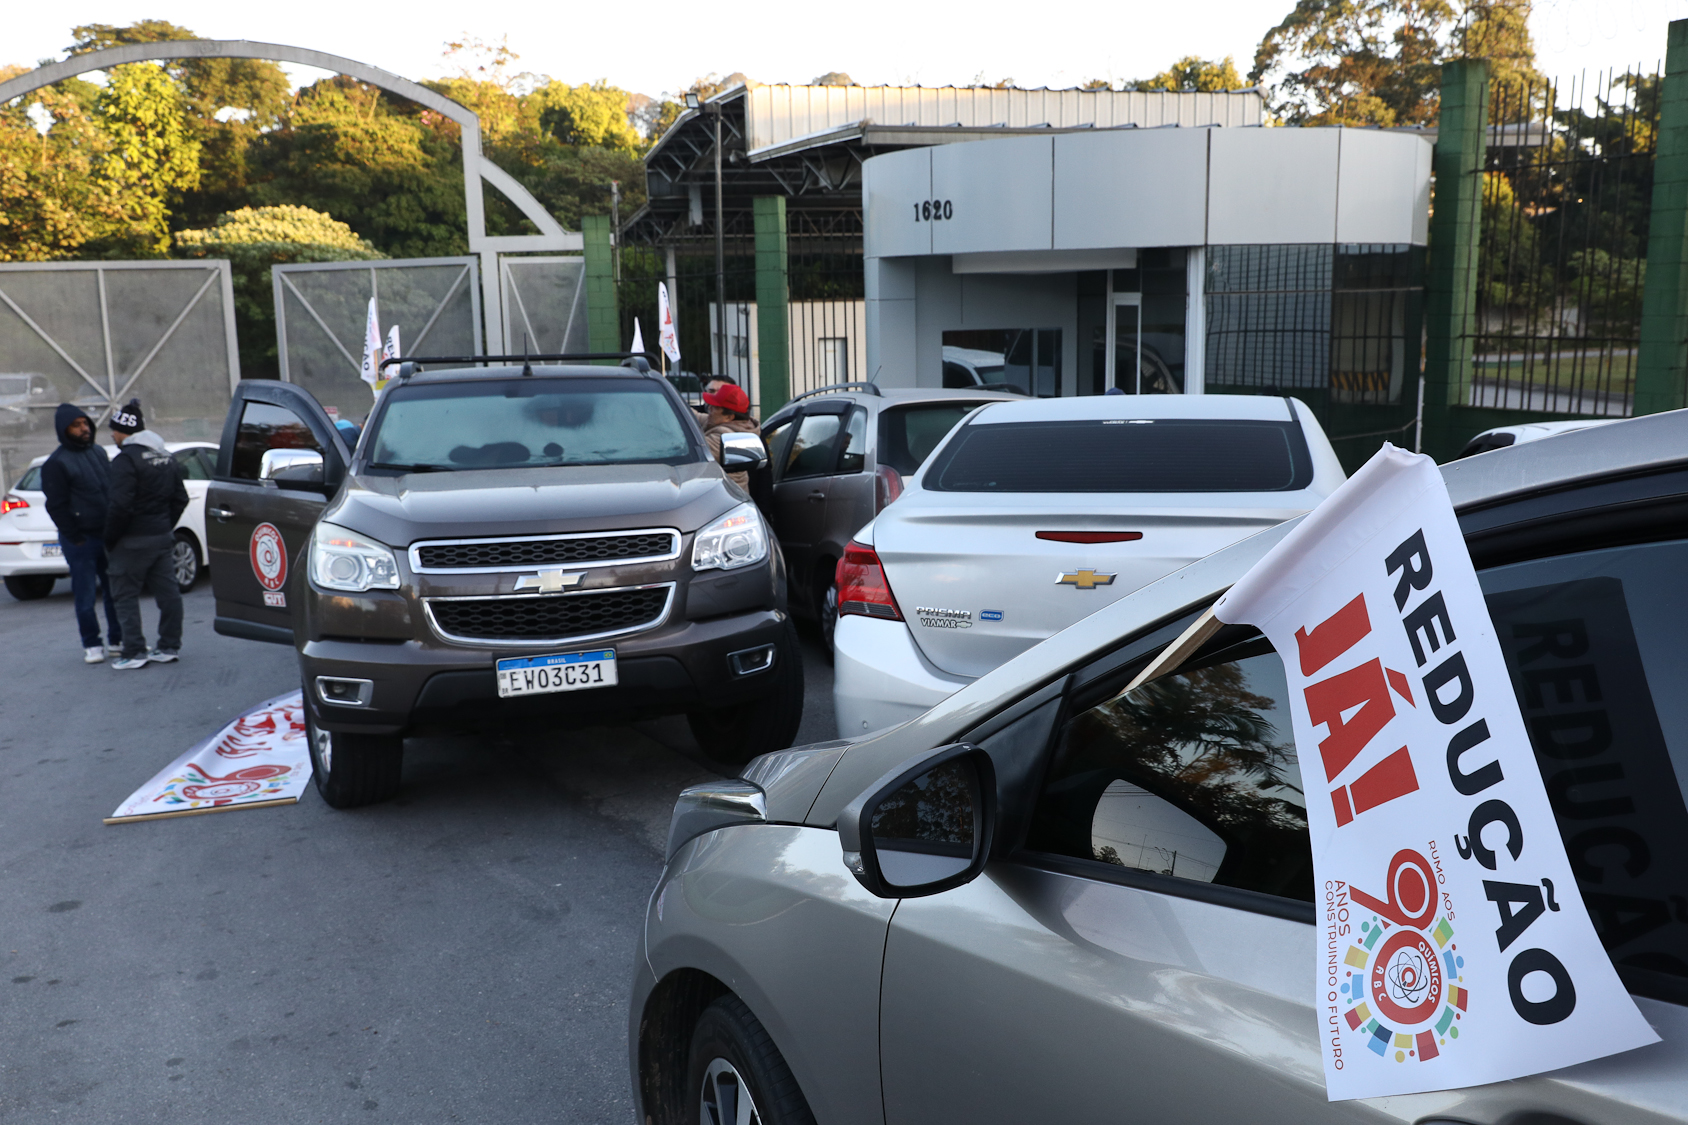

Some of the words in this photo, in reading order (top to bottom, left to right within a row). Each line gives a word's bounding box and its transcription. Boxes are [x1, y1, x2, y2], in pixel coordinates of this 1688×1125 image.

[913, 199, 953, 222] 1620
[264, 593, 283, 605] CUT
[915, 606, 972, 620] PRISMA
[920, 617, 958, 629] VIAMAR
[1294, 592, 1420, 828] JÁ!
[1384, 527, 1577, 1026] REDUÇÃO
[1334, 880, 1351, 937] ANOS
[1428, 840, 1446, 885] RUMO
[1441, 892, 1456, 922] AOS
[1325, 880, 1338, 987] CONSTRUINDO
[1327, 991, 1338, 1002] O
[1373, 965, 1387, 1002] ABC
[1418, 941, 1439, 1004] QUÍMICOS
[1328, 1005, 1344, 1071] FUTURO
